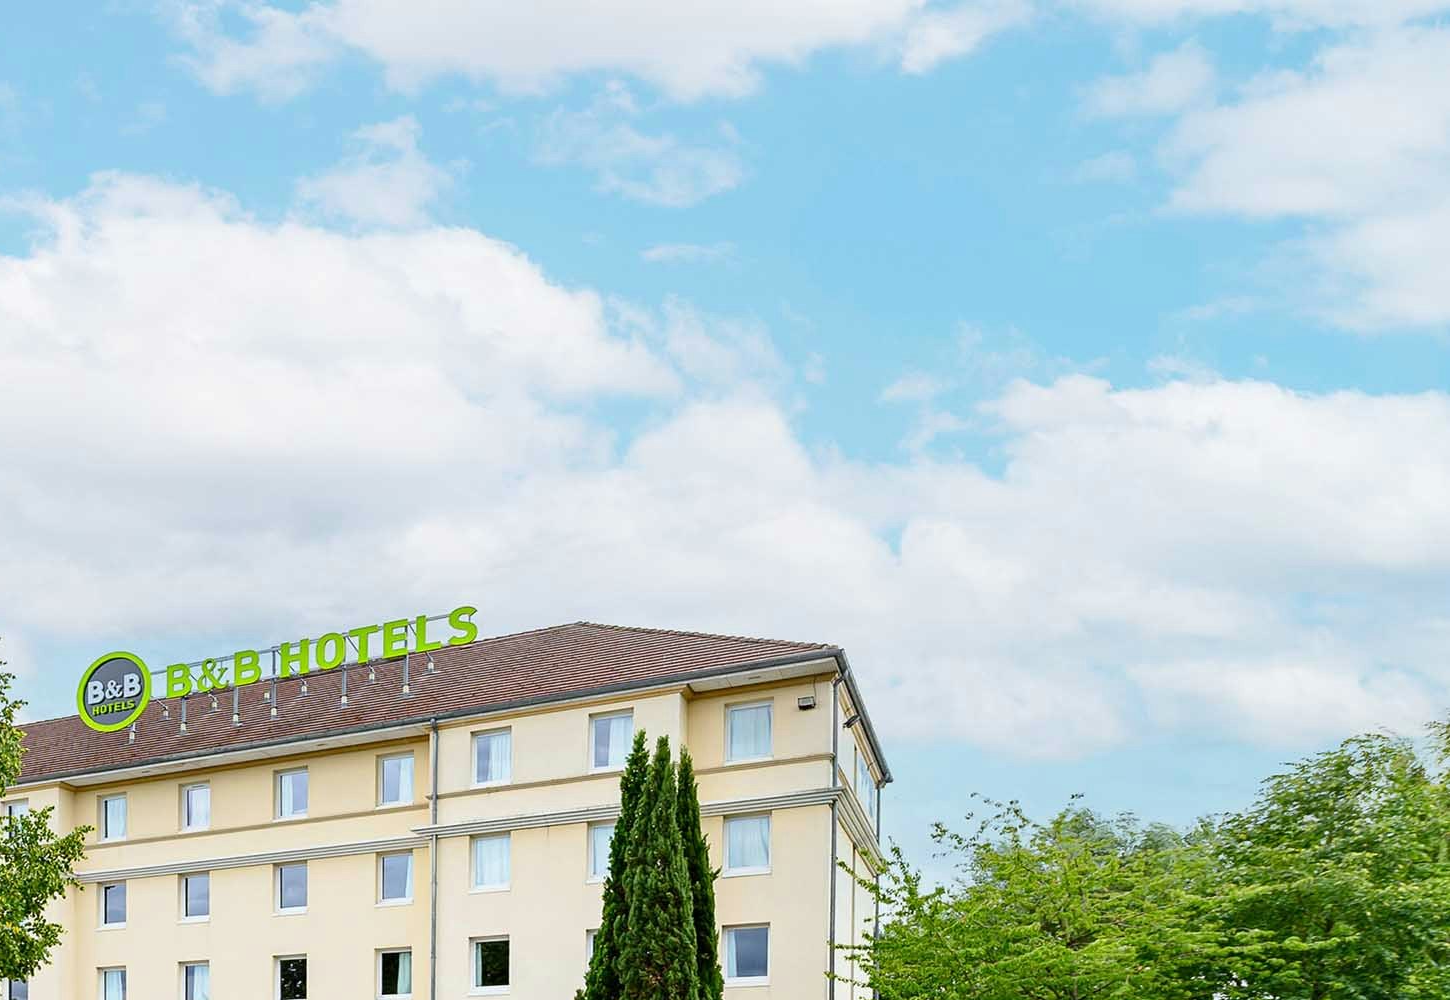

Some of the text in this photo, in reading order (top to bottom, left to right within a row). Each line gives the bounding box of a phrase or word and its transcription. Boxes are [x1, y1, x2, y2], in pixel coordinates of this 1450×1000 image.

[167, 606, 478, 698] B&B HOTELS
[87, 673, 141, 705] B&B
[92, 700, 136, 715] HOTELS
